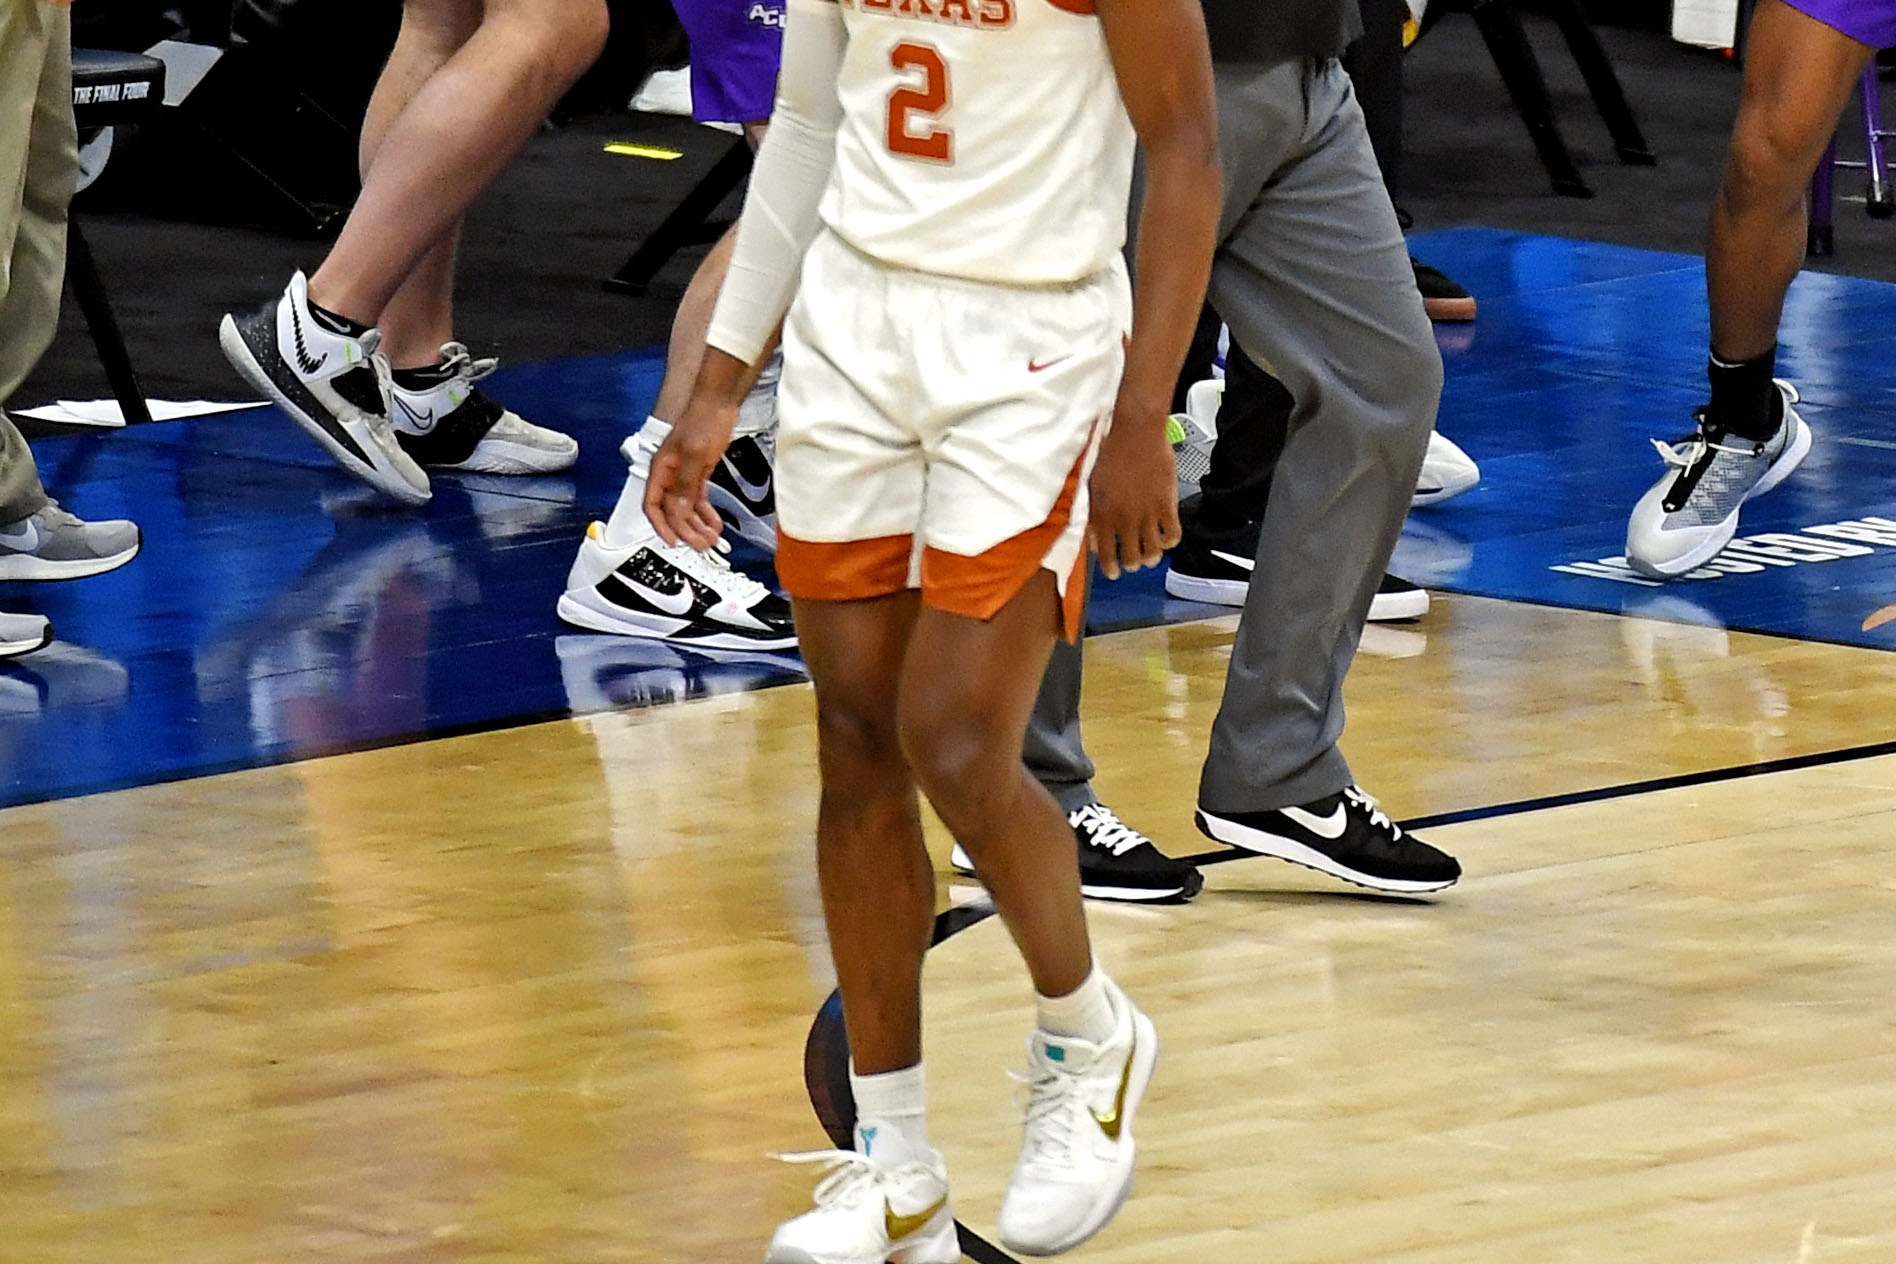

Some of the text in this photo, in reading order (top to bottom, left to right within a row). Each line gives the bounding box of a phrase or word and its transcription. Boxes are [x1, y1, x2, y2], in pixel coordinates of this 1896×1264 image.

[92, 84, 120, 103] FINAL
[121, 81, 151, 101] FOUR
[884, 38, 955, 165] 2
